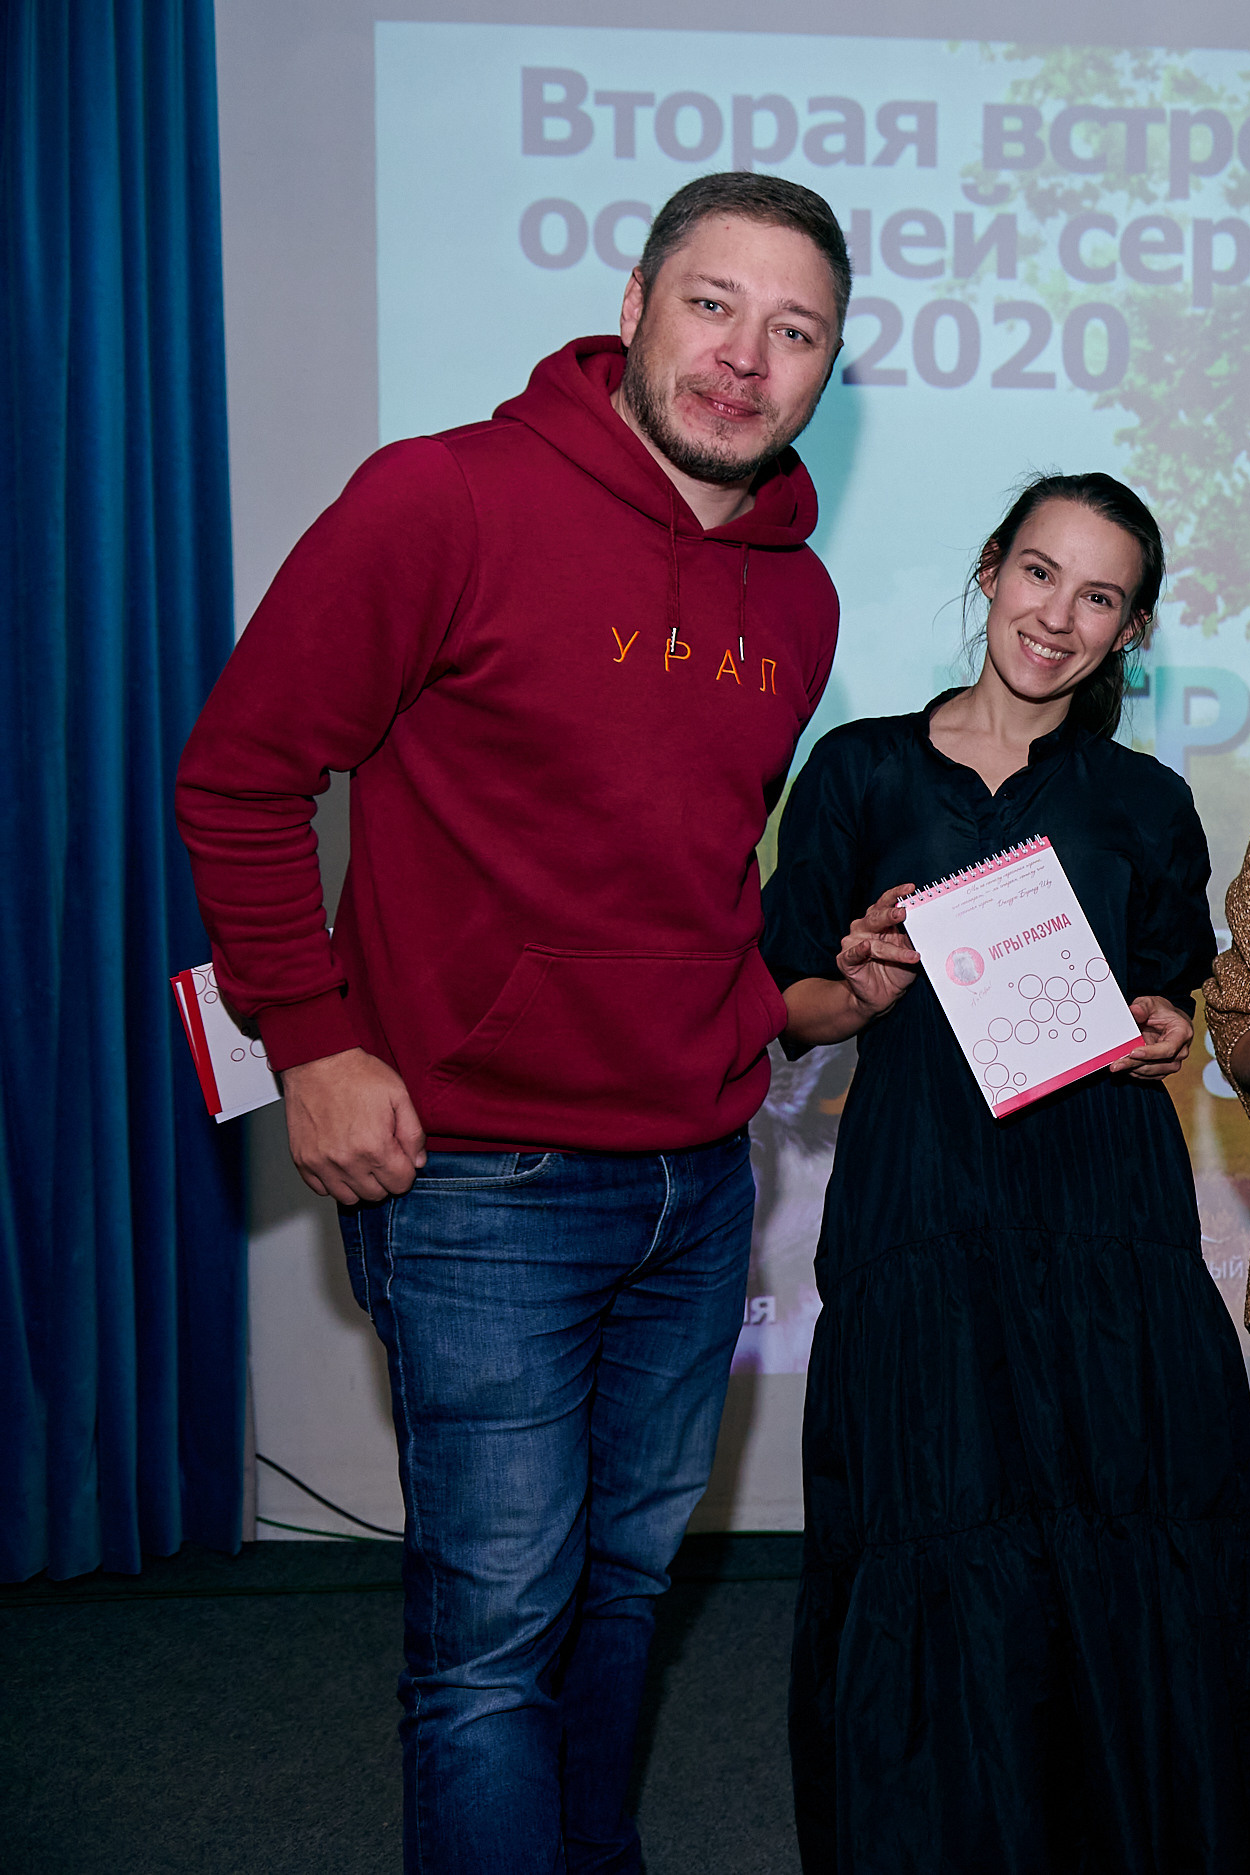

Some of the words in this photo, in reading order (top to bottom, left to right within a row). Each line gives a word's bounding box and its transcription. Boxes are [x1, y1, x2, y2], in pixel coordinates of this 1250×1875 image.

[519, 66, 938, 172] Вторая
[841, 296, 1130, 391] 2020
[611, 626, 777, 695] УРАЛ
[988, 934, 1024, 961] ИГРЫ
[1022, 913, 1072, 945] РАЗУМА
